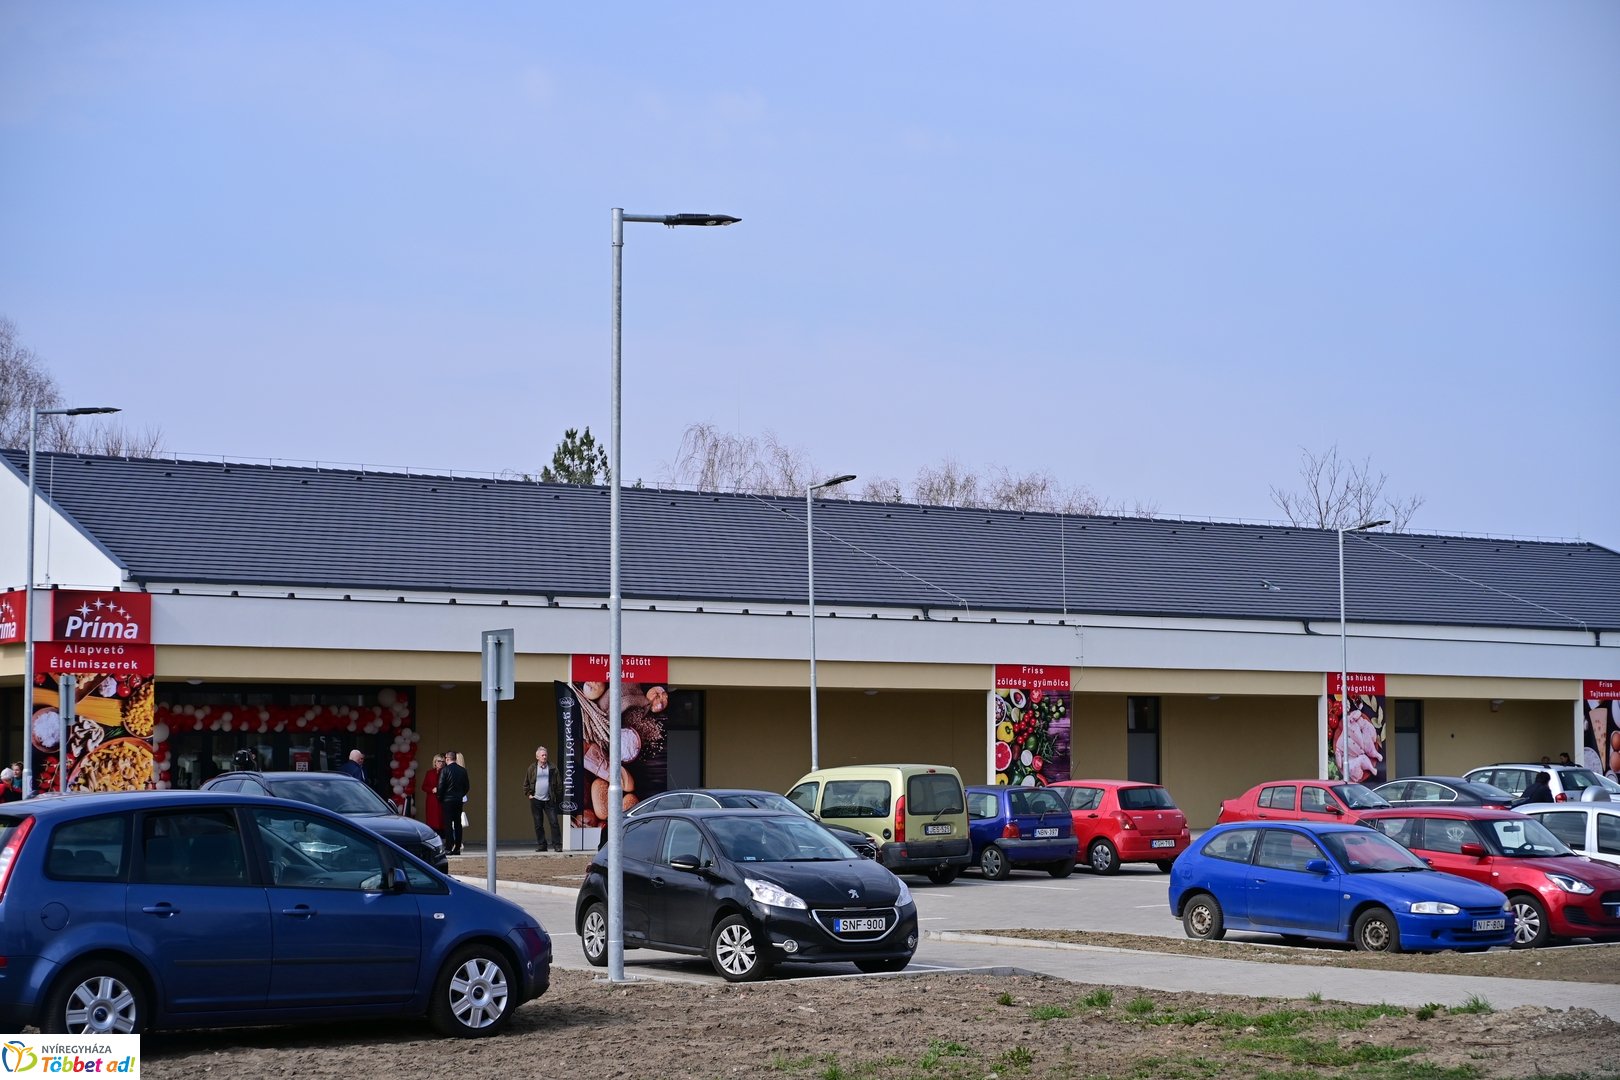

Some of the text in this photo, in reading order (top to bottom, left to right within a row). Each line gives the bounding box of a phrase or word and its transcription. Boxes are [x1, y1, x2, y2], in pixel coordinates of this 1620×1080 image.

[64, 615, 139, 640] Príma
[64, 644, 125, 656] Alapvető
[50, 657, 138, 670] Élelmiszerek
[589, 656, 651, 667] Helyn sütött
[606, 670, 635, 680] páru
[1022, 666, 1044, 675] Friss
[997, 677, 1027, 688] zöldség
[1033, 679, 1069, 688] gyümölcs
[1355, 674, 1376, 682] húsok
[1336, 684, 1376, 693] Fvágottak
[842, 919, 884, 931] SNF-900
[1477, 920, 1504, 930] NIF-804
